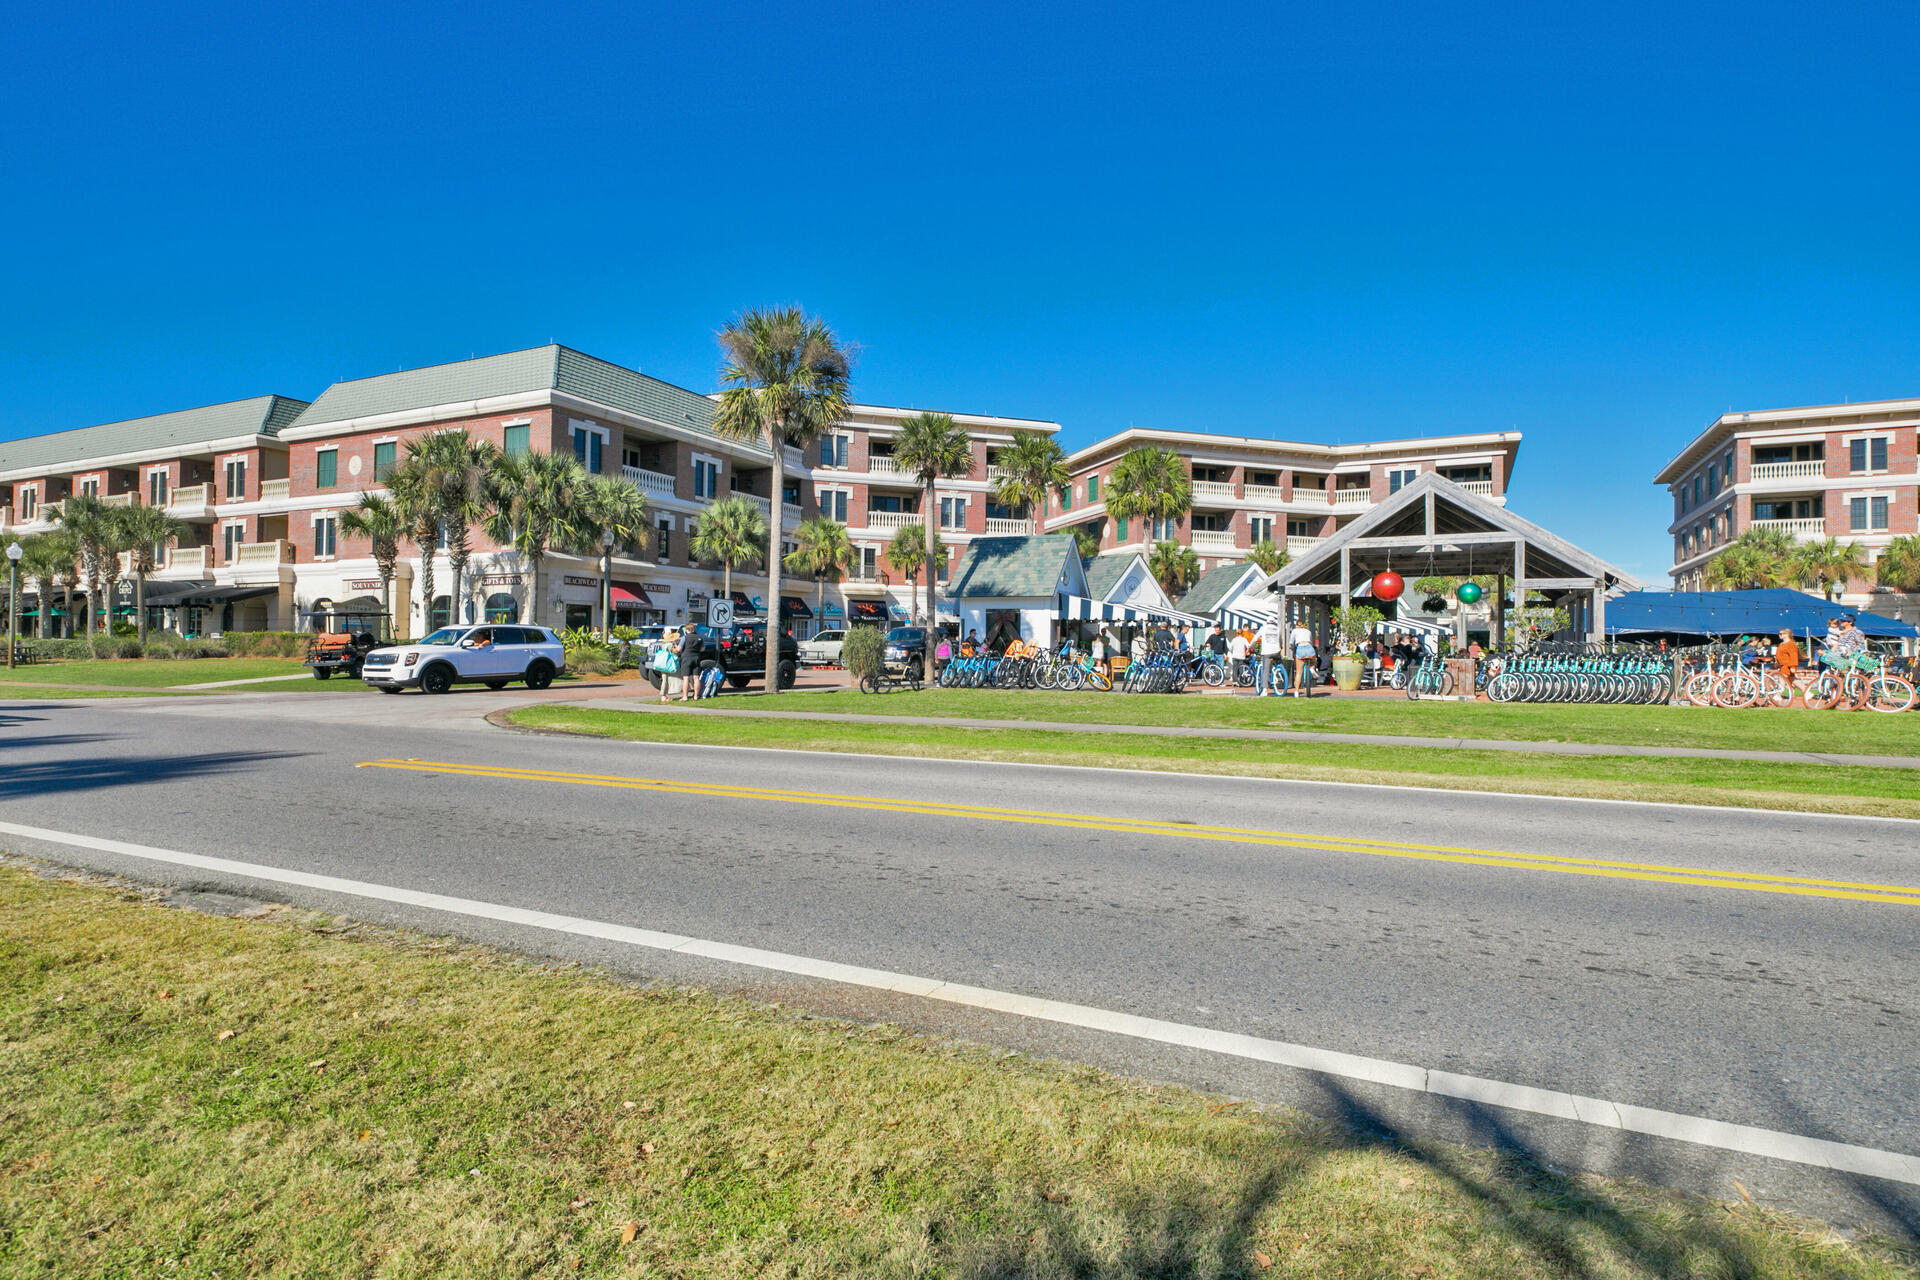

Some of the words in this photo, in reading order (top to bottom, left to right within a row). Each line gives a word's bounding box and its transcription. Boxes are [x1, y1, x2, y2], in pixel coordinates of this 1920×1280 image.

[482, 577, 498, 585] GIFTS
[505, 576, 521, 584] TOYS
[565, 577, 597, 585] BEACHWEAR
